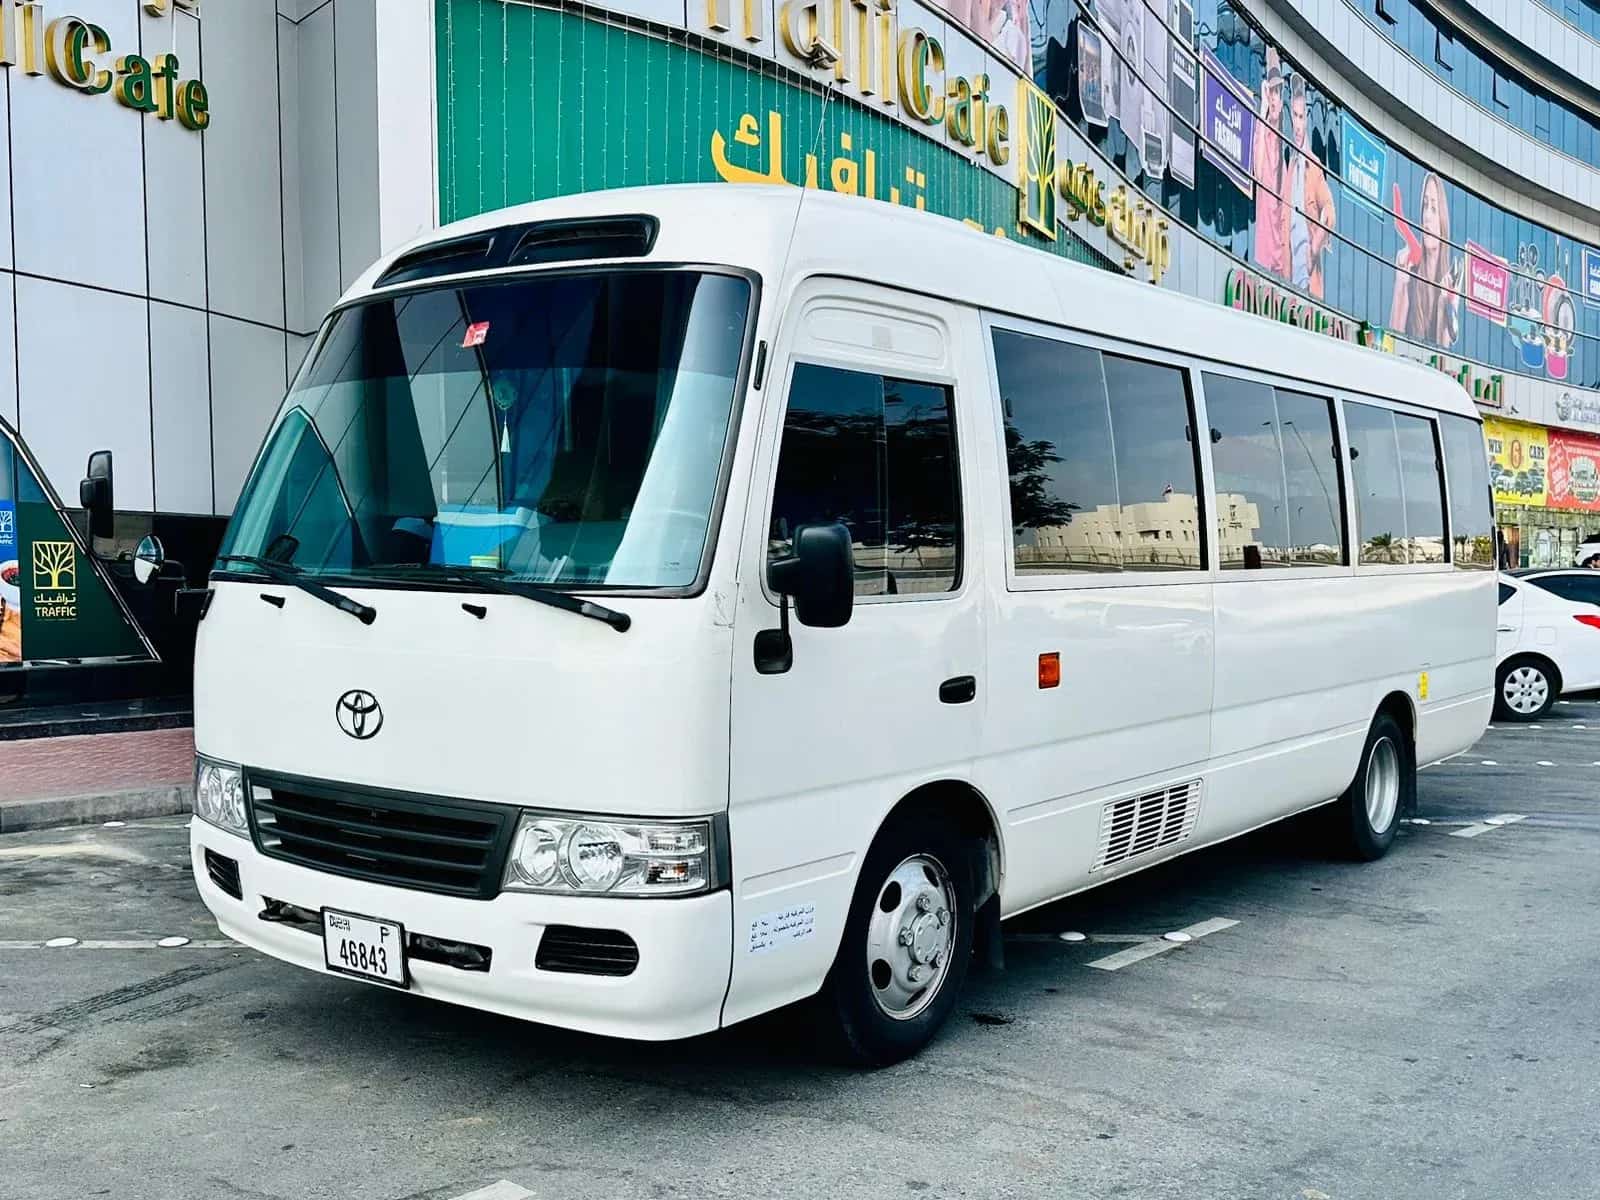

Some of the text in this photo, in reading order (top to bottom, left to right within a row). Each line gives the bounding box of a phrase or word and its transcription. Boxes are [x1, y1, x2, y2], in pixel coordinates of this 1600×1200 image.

[66, 23, 210, 130] Cafe
[908, 36, 1010, 166] Cafe
[1215, 116, 1242, 162] FASHION
[1529, 445, 1545, 460] CARS
[34, 606, 77, 617] TRAFFIC
[340, 938, 388, 975] 46843
